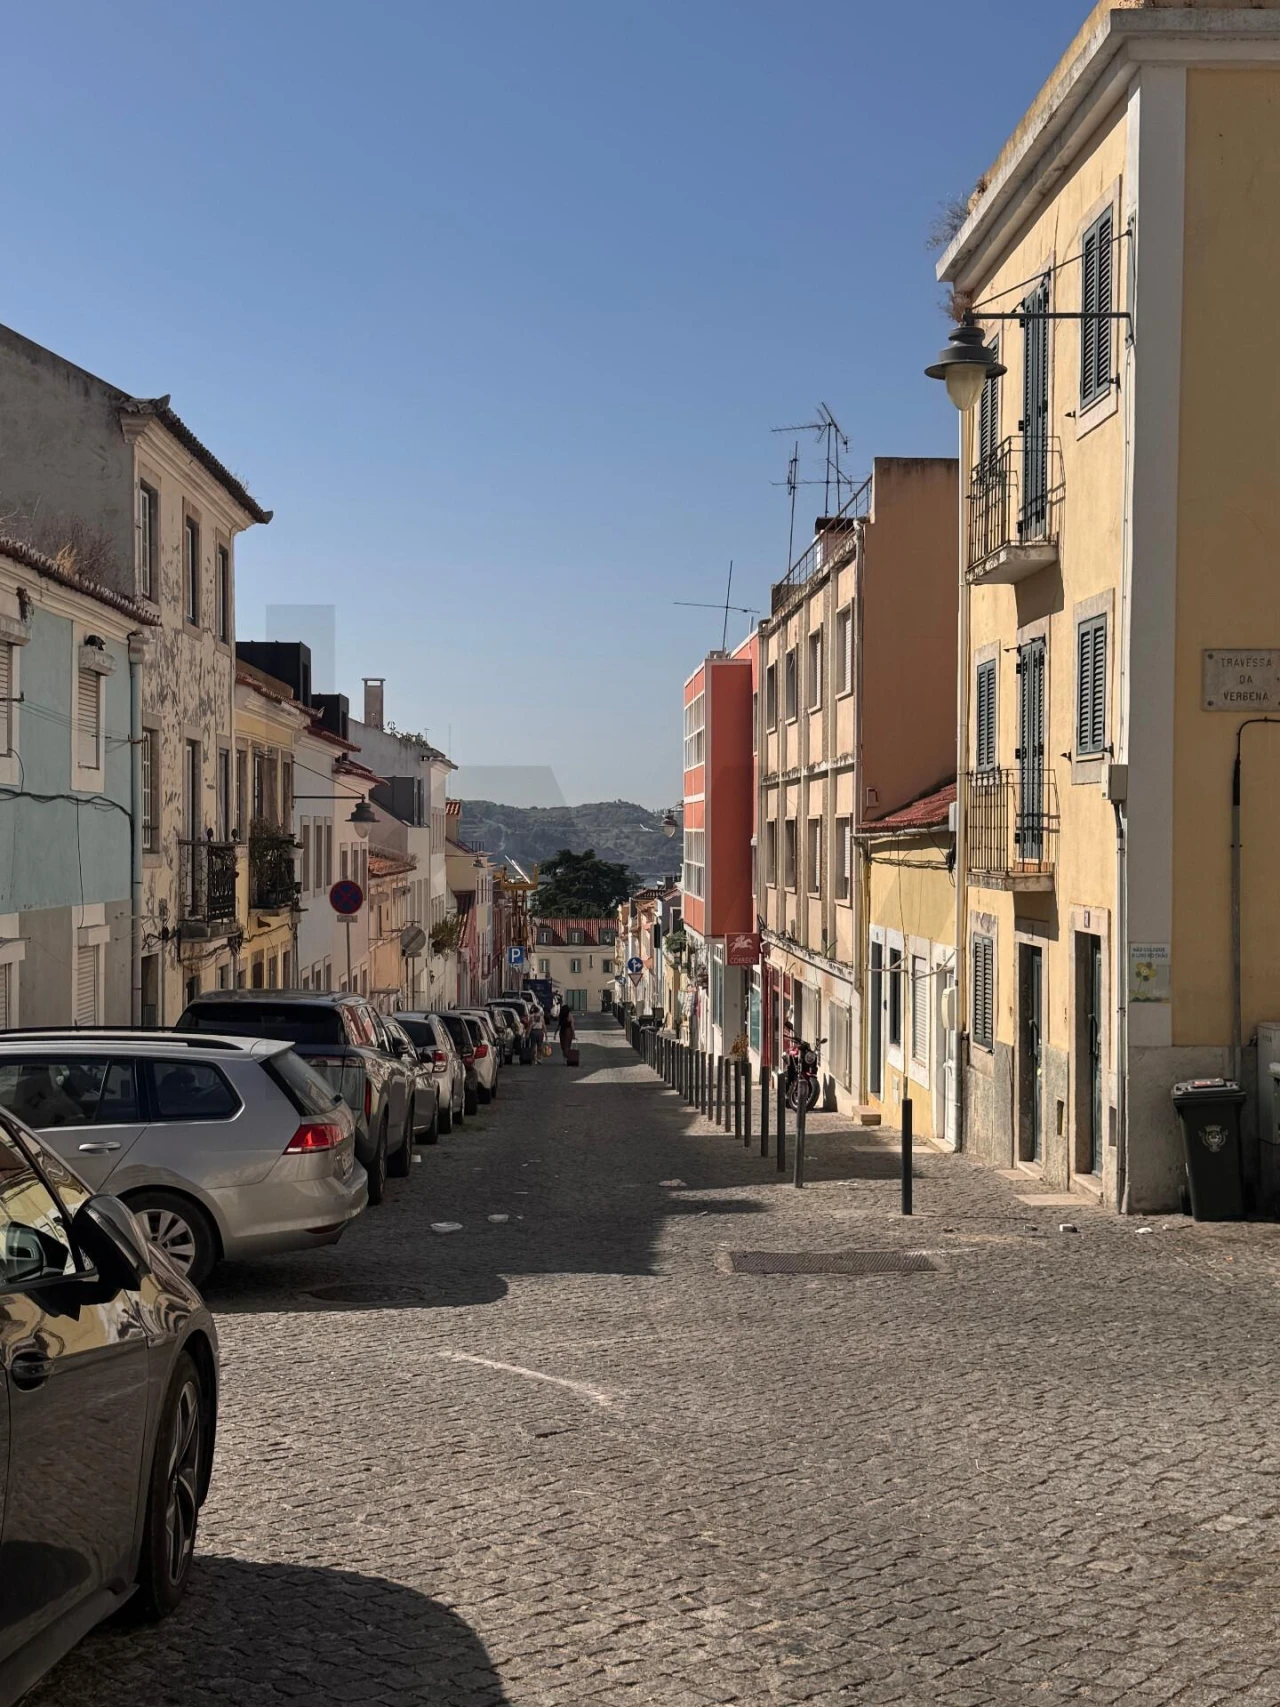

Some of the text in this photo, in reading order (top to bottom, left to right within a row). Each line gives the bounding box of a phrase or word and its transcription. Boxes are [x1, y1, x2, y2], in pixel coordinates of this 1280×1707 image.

[1221, 658, 1272, 668] TRAVESSA
[1239, 675, 1254, 685] DA
[1223, 691, 1269, 702] VERBENA
[511, 948, 521, 963] P
